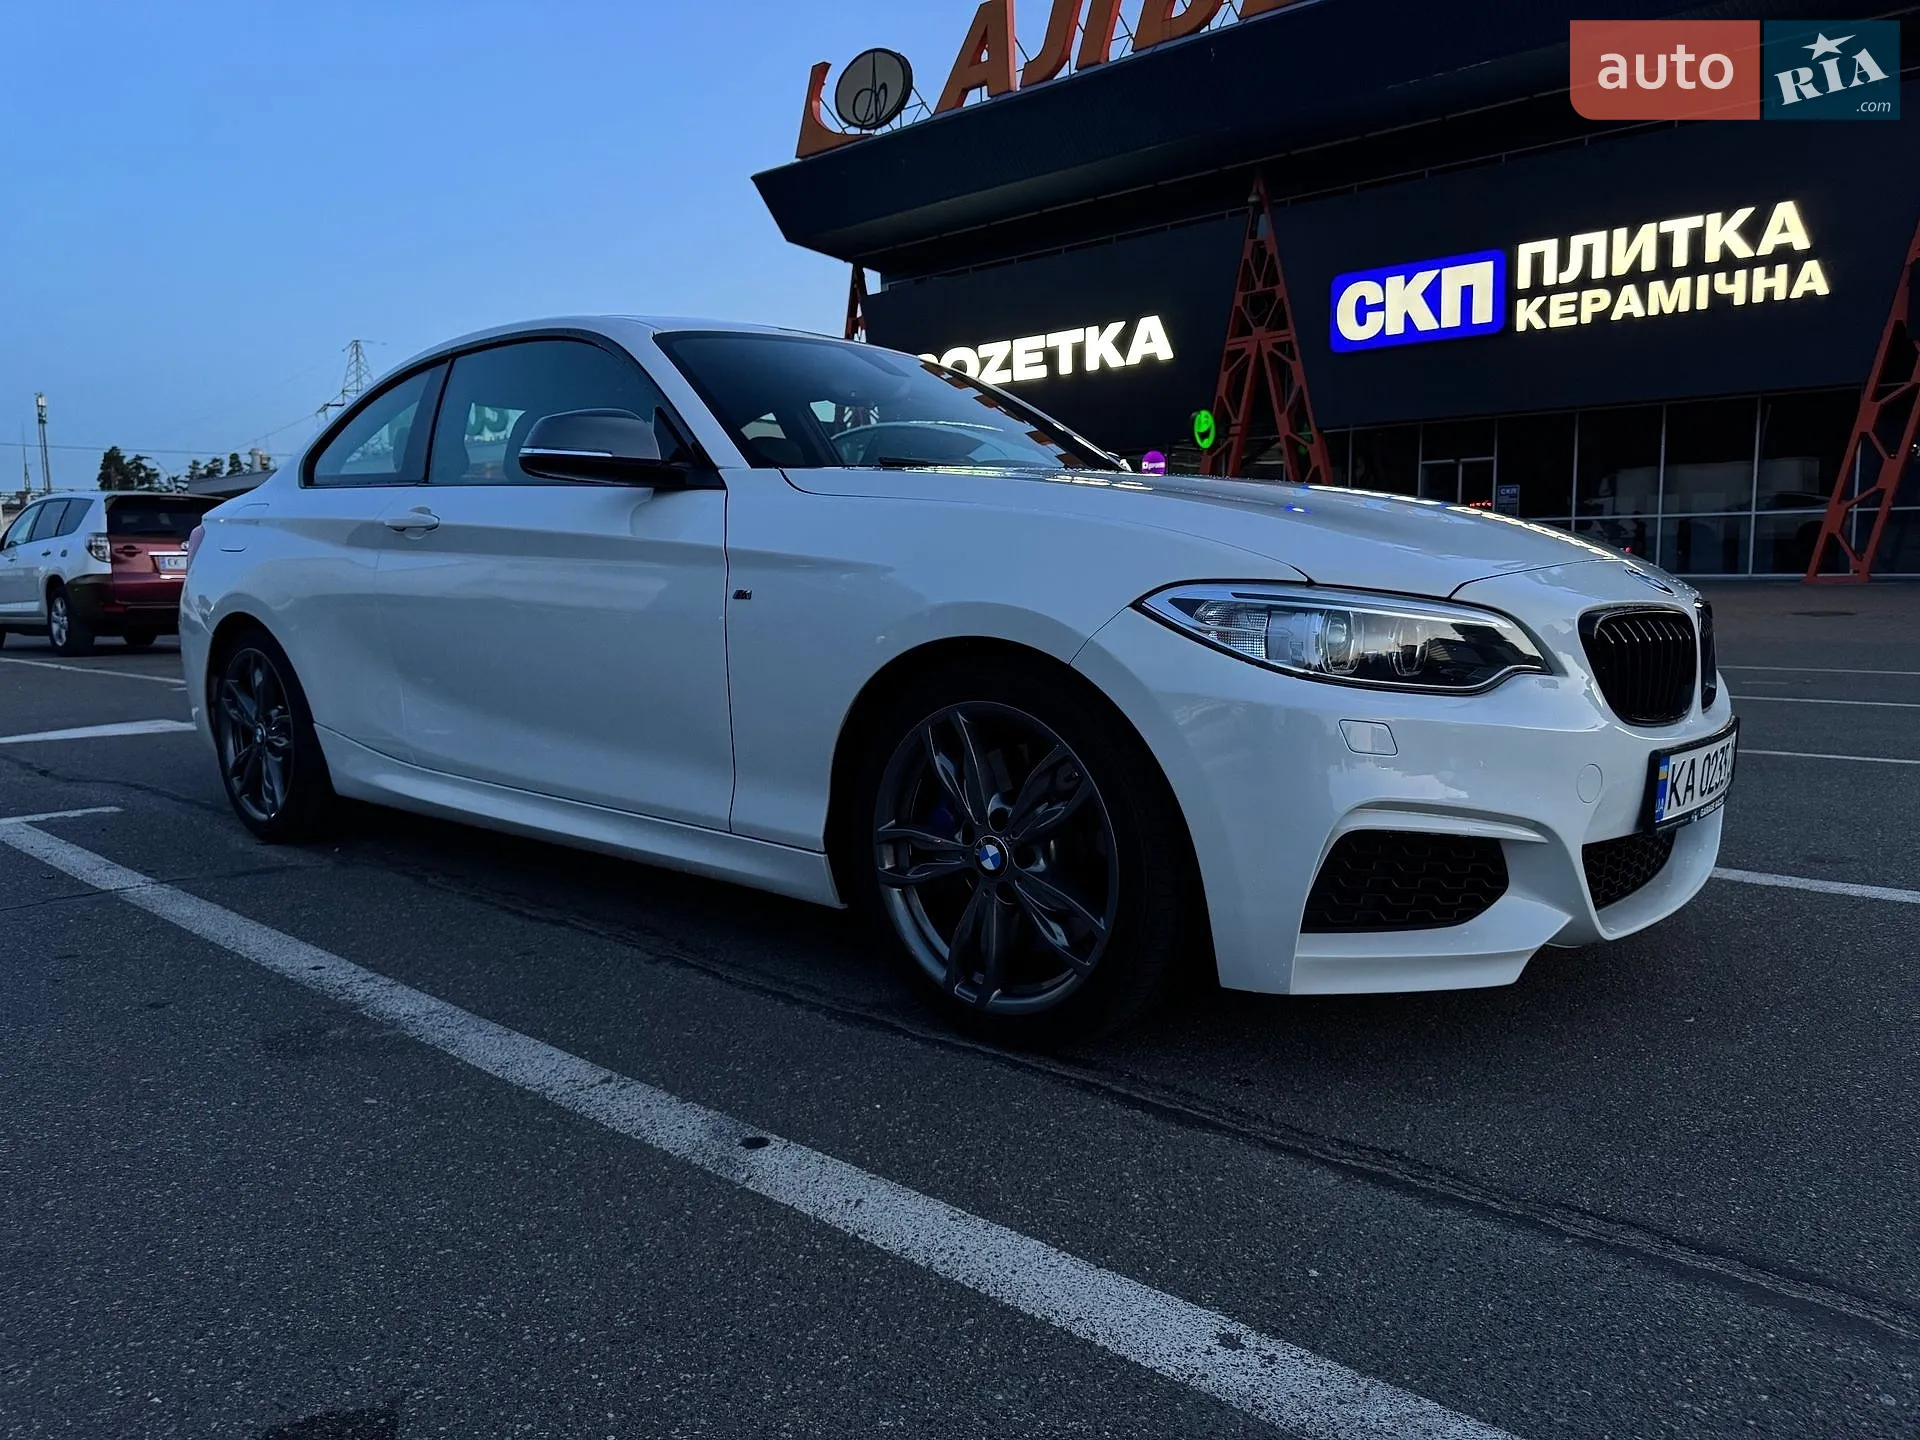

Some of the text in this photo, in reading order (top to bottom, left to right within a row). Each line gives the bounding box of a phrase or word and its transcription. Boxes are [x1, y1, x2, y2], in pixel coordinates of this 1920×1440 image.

[1516, 200, 1811, 290] ПЛИТКА
[1336, 260, 1494, 342] СКП
[1515, 259, 1830, 332] КЕРАМІЧНА
[917, 315, 1174, 386] OZETKA
[1667, 757, 1696, 811] KA
